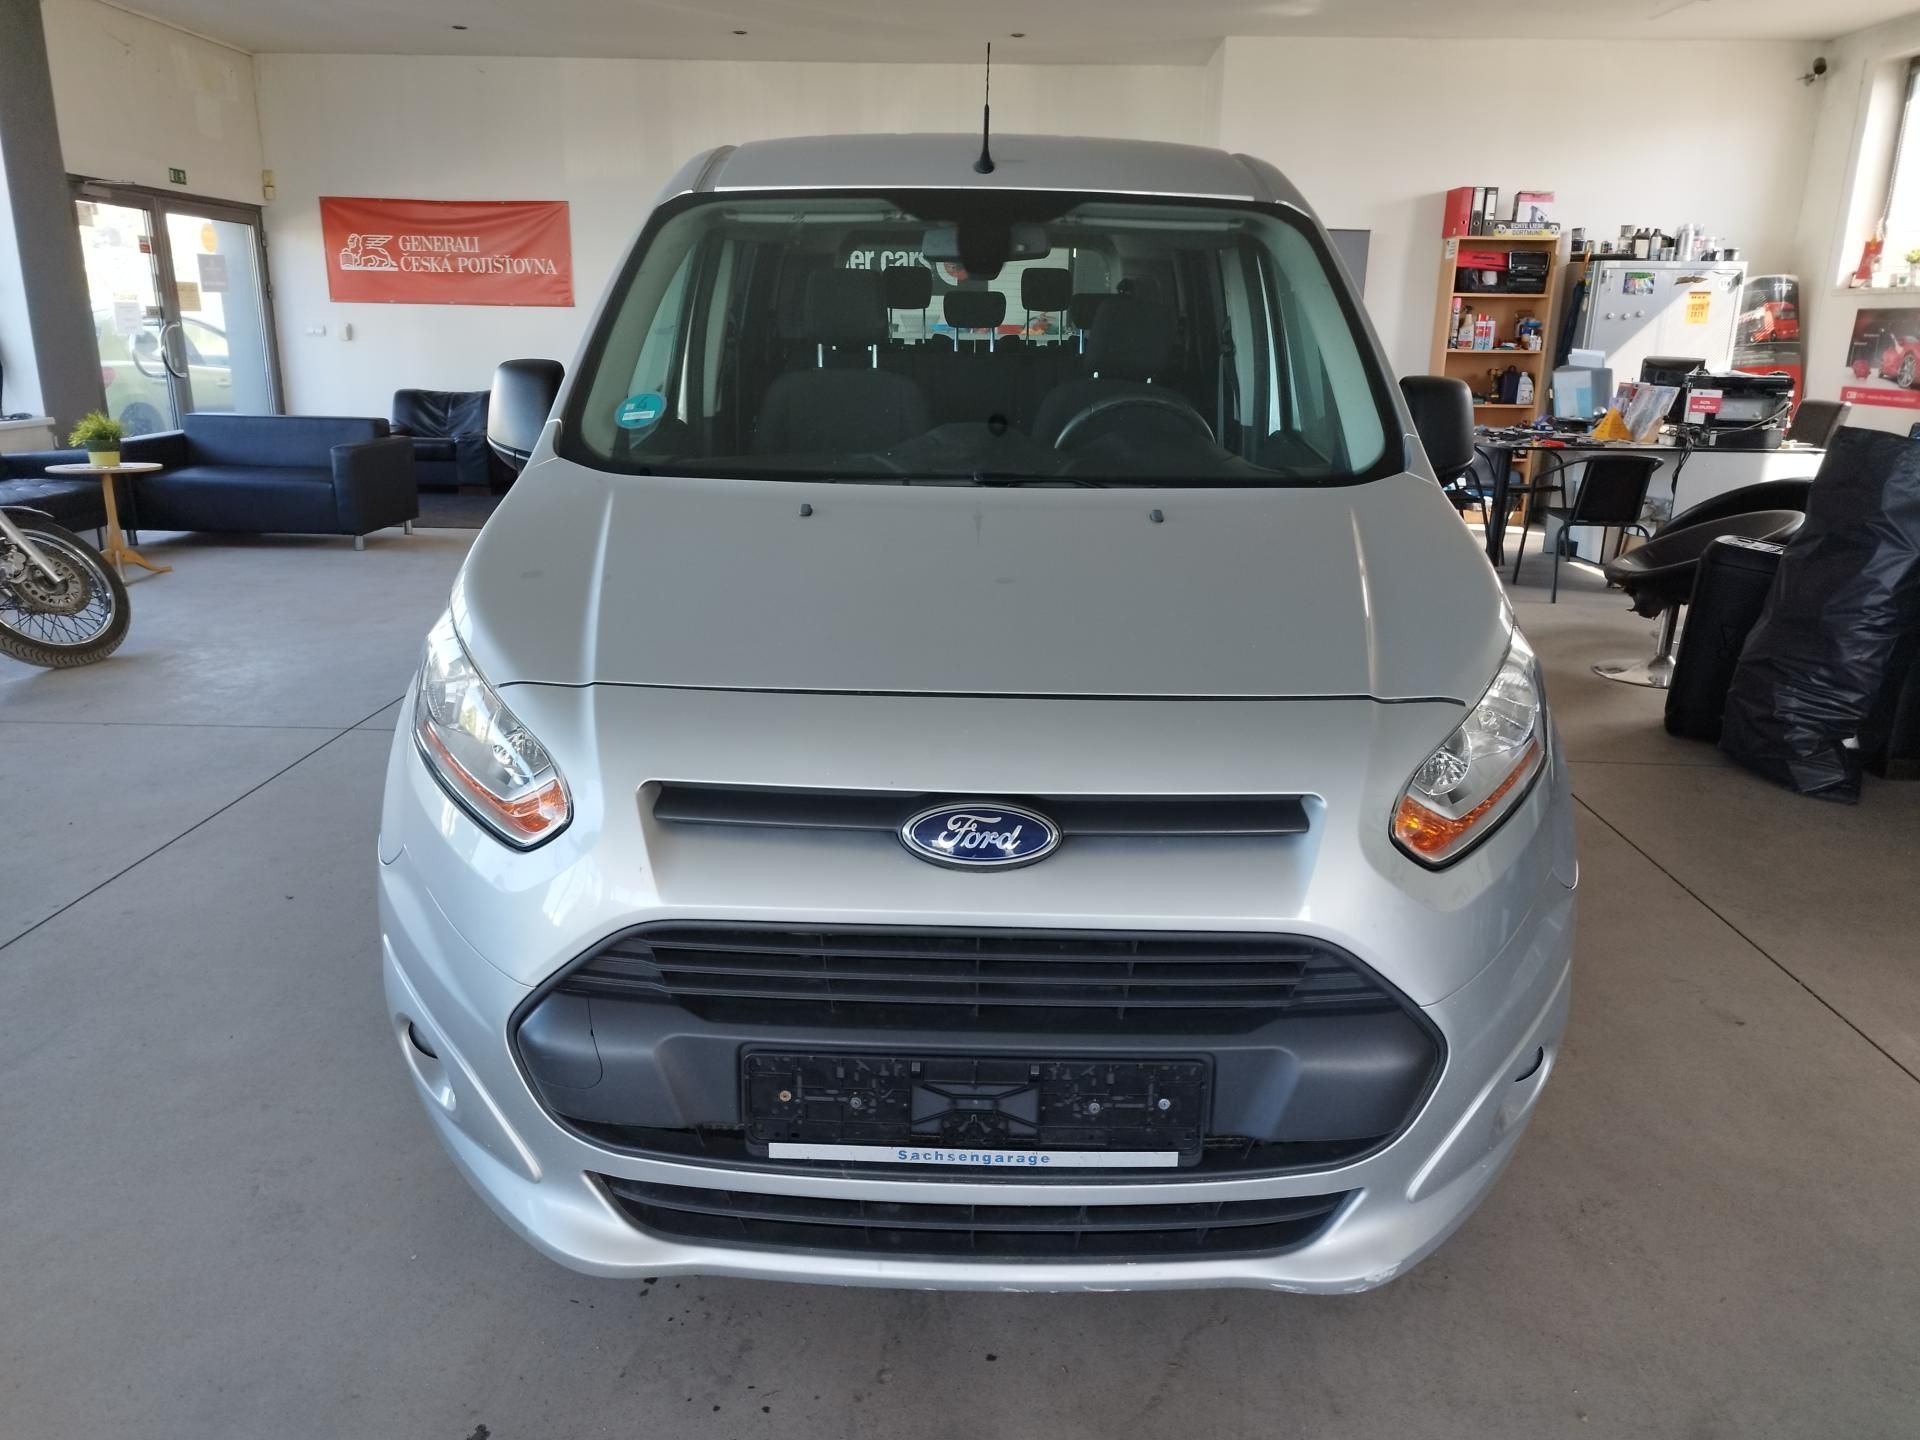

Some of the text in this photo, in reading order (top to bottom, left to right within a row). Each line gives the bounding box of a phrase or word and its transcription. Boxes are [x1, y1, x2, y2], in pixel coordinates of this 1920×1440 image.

[398, 235, 480, 252] GENERALI
[400, 253, 558, 275] ČESKÁ POJIŠŤOVNA
[938, 814, 1023, 850] Ford
[898, 1150, 1050, 1165] Sachsengarage
